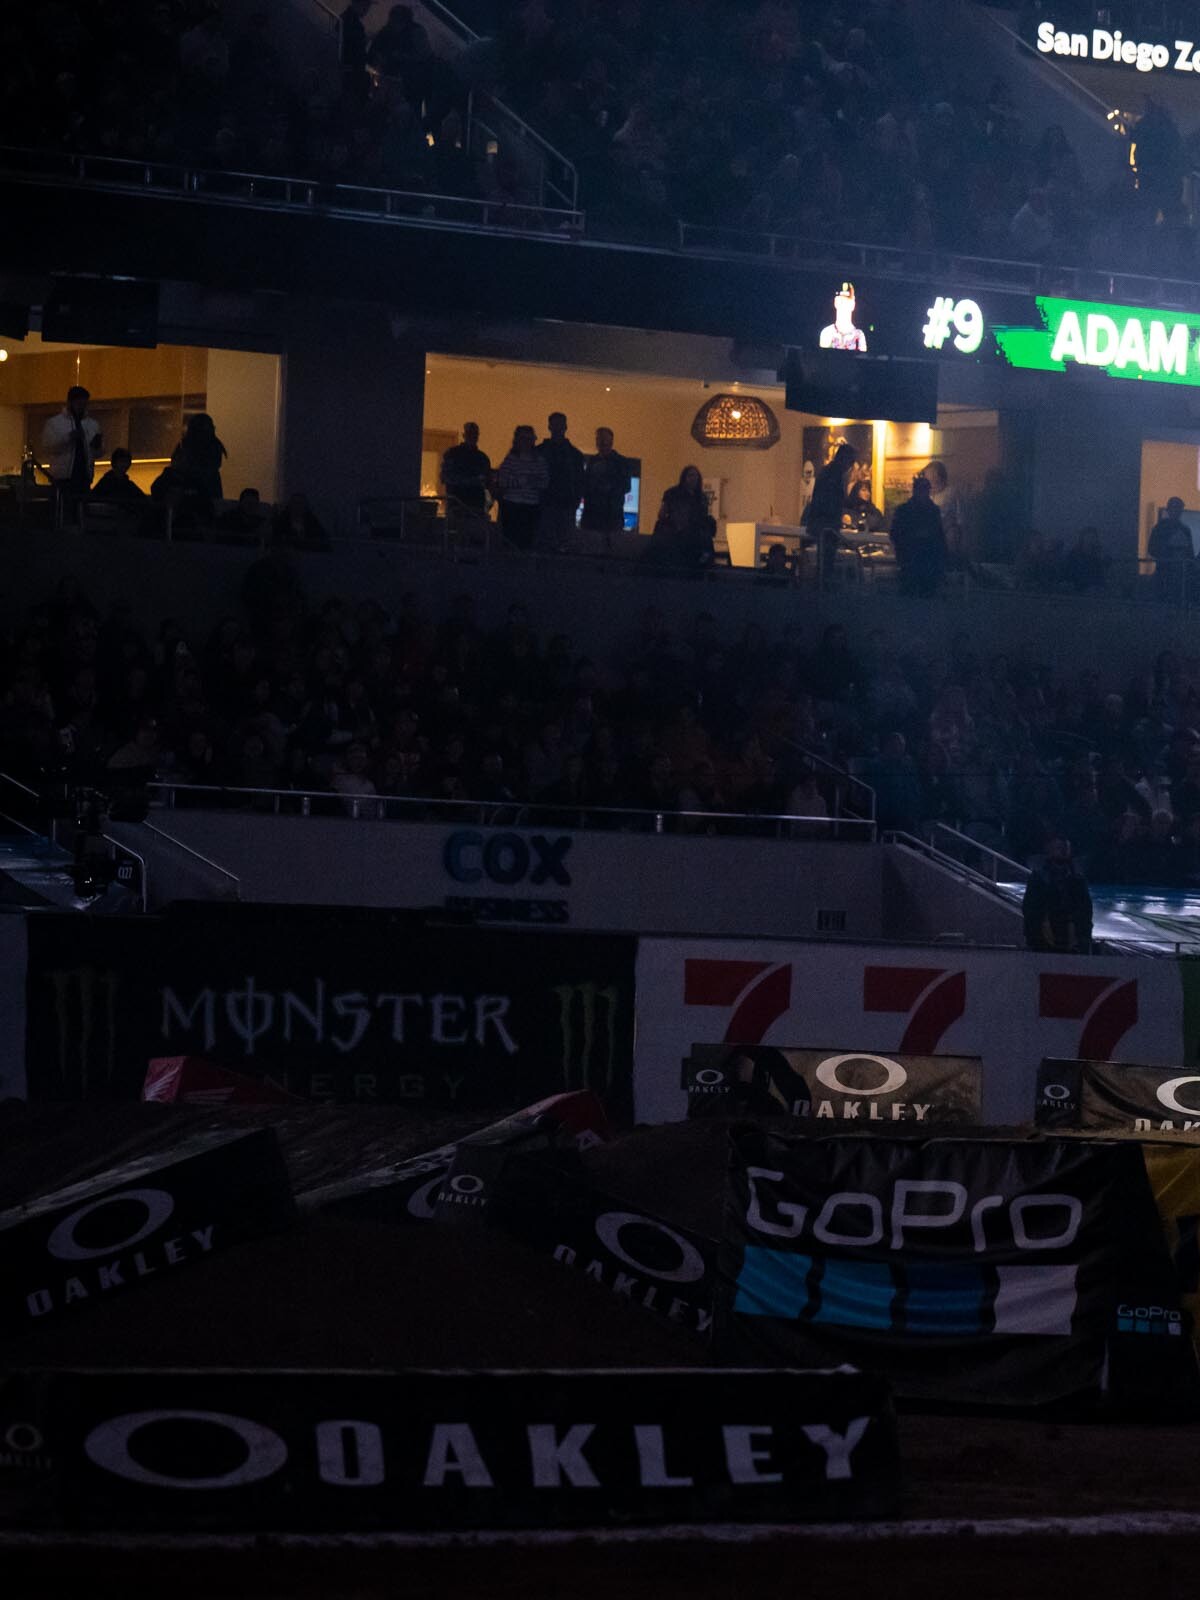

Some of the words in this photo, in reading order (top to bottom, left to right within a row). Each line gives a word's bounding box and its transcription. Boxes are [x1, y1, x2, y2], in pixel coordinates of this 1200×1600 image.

[1037, 21, 1088, 57] San
[1092, 29, 1169, 72] Diego
[922, 297, 984, 353] #9
[1050, 311, 1189, 376] ADAM
[445, 831, 572, 886] COX
[158, 976, 519, 1056] MONSTER
[264, 1071, 466, 1099] NERGY
[745, 1165, 1082, 1253] GoPro
[25, 1224, 219, 1318] OAKLEY
[1116, 1303, 1182, 1322] GoPro
[314, 1416, 871, 1488] OAKLEY
